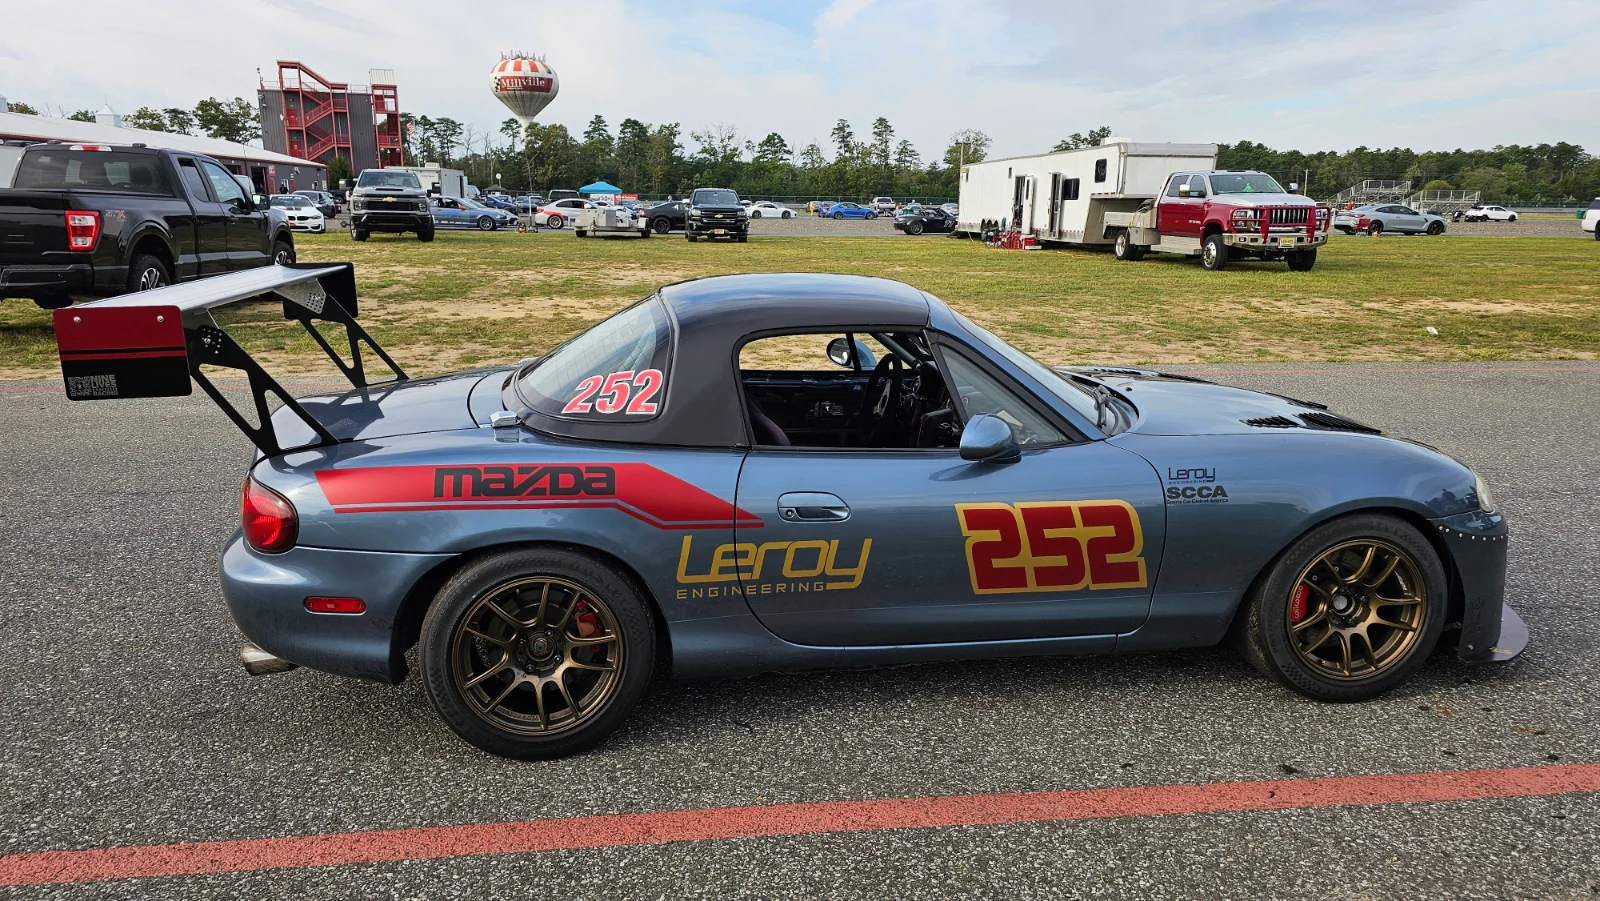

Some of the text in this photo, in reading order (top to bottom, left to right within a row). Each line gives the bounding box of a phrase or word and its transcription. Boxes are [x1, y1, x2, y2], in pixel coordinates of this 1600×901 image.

[501, 77, 545, 88] Millville
[90, 375, 116, 383] NINE
[91, 381, 117, 389] LIVES
[561, 369, 663, 415] 252
[1168, 467, 1216, 482] Leroy
[1166, 485, 1229, 499] SCCA
[955, 499, 1148, 595] 252
[676, 535, 873, 590] Leroy
[676, 582, 824, 599] ENGINEERING
